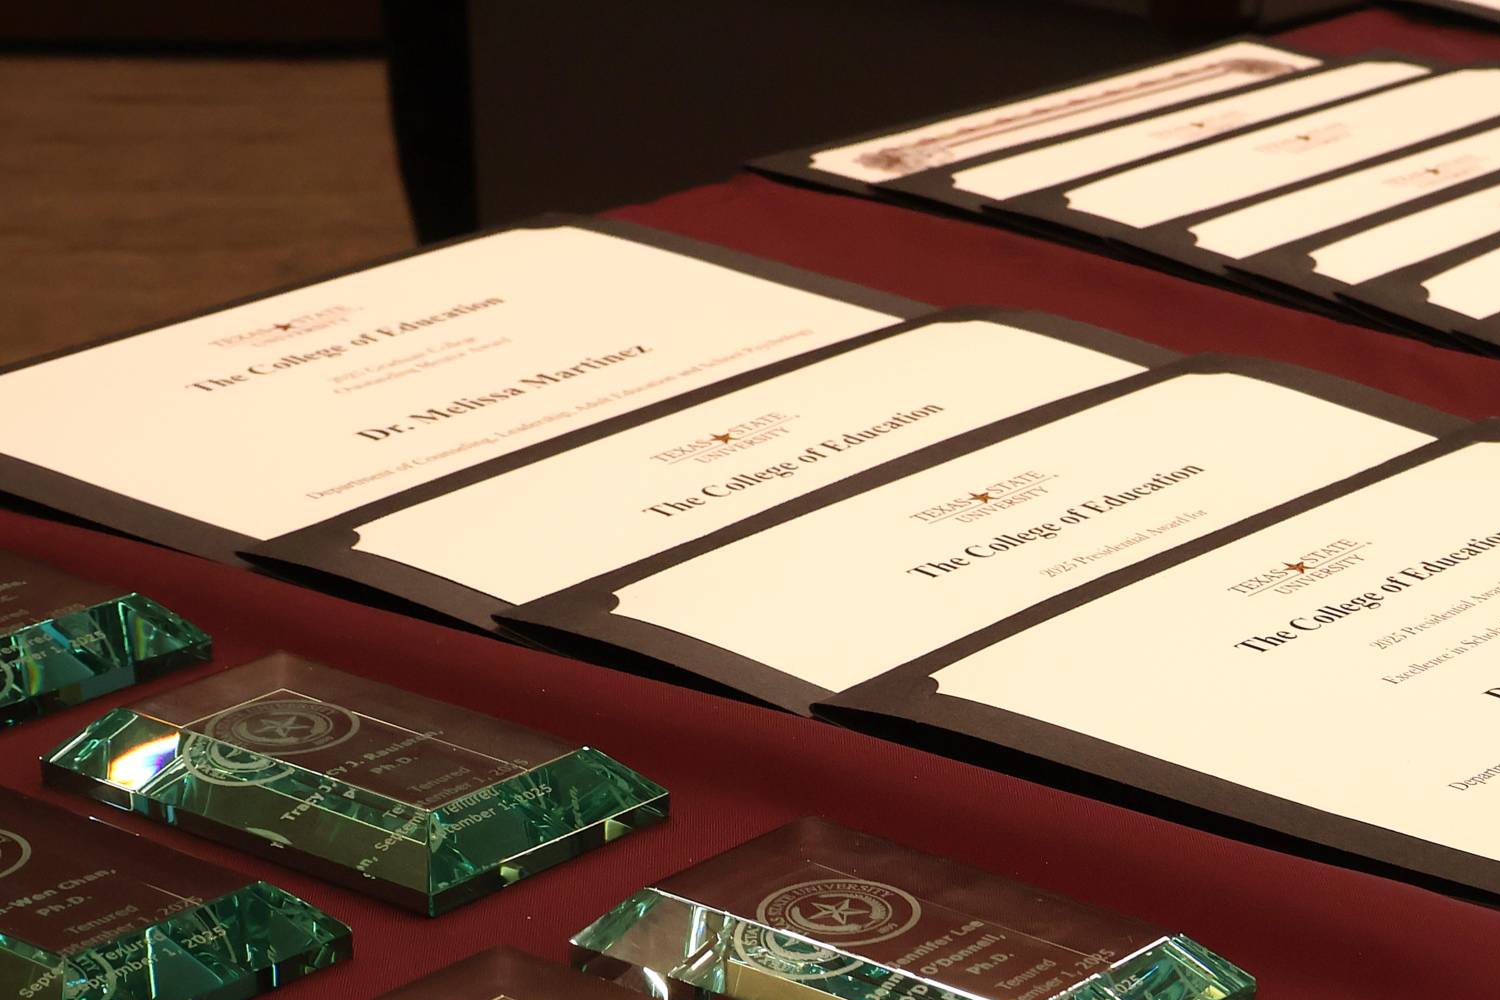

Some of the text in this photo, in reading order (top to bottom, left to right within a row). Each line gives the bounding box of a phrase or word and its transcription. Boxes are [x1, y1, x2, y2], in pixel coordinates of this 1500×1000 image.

[184, 297, 506, 392] The College of Education
[354, 345, 654, 442] Dr. Melissa Martinez
[649, 411, 787, 464] TEXAS STATE
[693, 425, 791, 464] UNIVERSITY
[305, 468, 396, 500] Department
[395, 453, 413, 471] of
[641, 402, 946, 518] The College of Education
[909, 470, 1047, 523] TEXAS STATE
[954, 485, 1050, 525] UNIVERSITY
[906, 462, 1207, 579] The College of Education
[1040, 507, 1209, 578] 2025 Presidential Award for
[1226, 536, 1359, 596] TEXAS STATE
[1273, 552, 1366, 596] UNIVERSITY
[1233, 627, 1299, 653] The
[1288, 591, 1385, 631] College
[1380, 575, 1414, 594] of
[1368, 628, 1409, 651] 2025
[1401, 599, 1477, 638] Presidential
[1381, 648, 1454, 686] Excellence
[1450, 644, 1470, 657] in
[57, 868, 118, 891] Chan,
[795, 882, 896, 898] UNIVERSITY
[35, 895, 93, 918] Ph.D.
[63, 903, 141, 936] Tenured
[949, 919, 985, 936] Lee
[919, 933, 1007, 976] O'Donnell,
[964, 952, 1015, 976] Ph.D.
[994, 958, 1057, 991] Tenured
